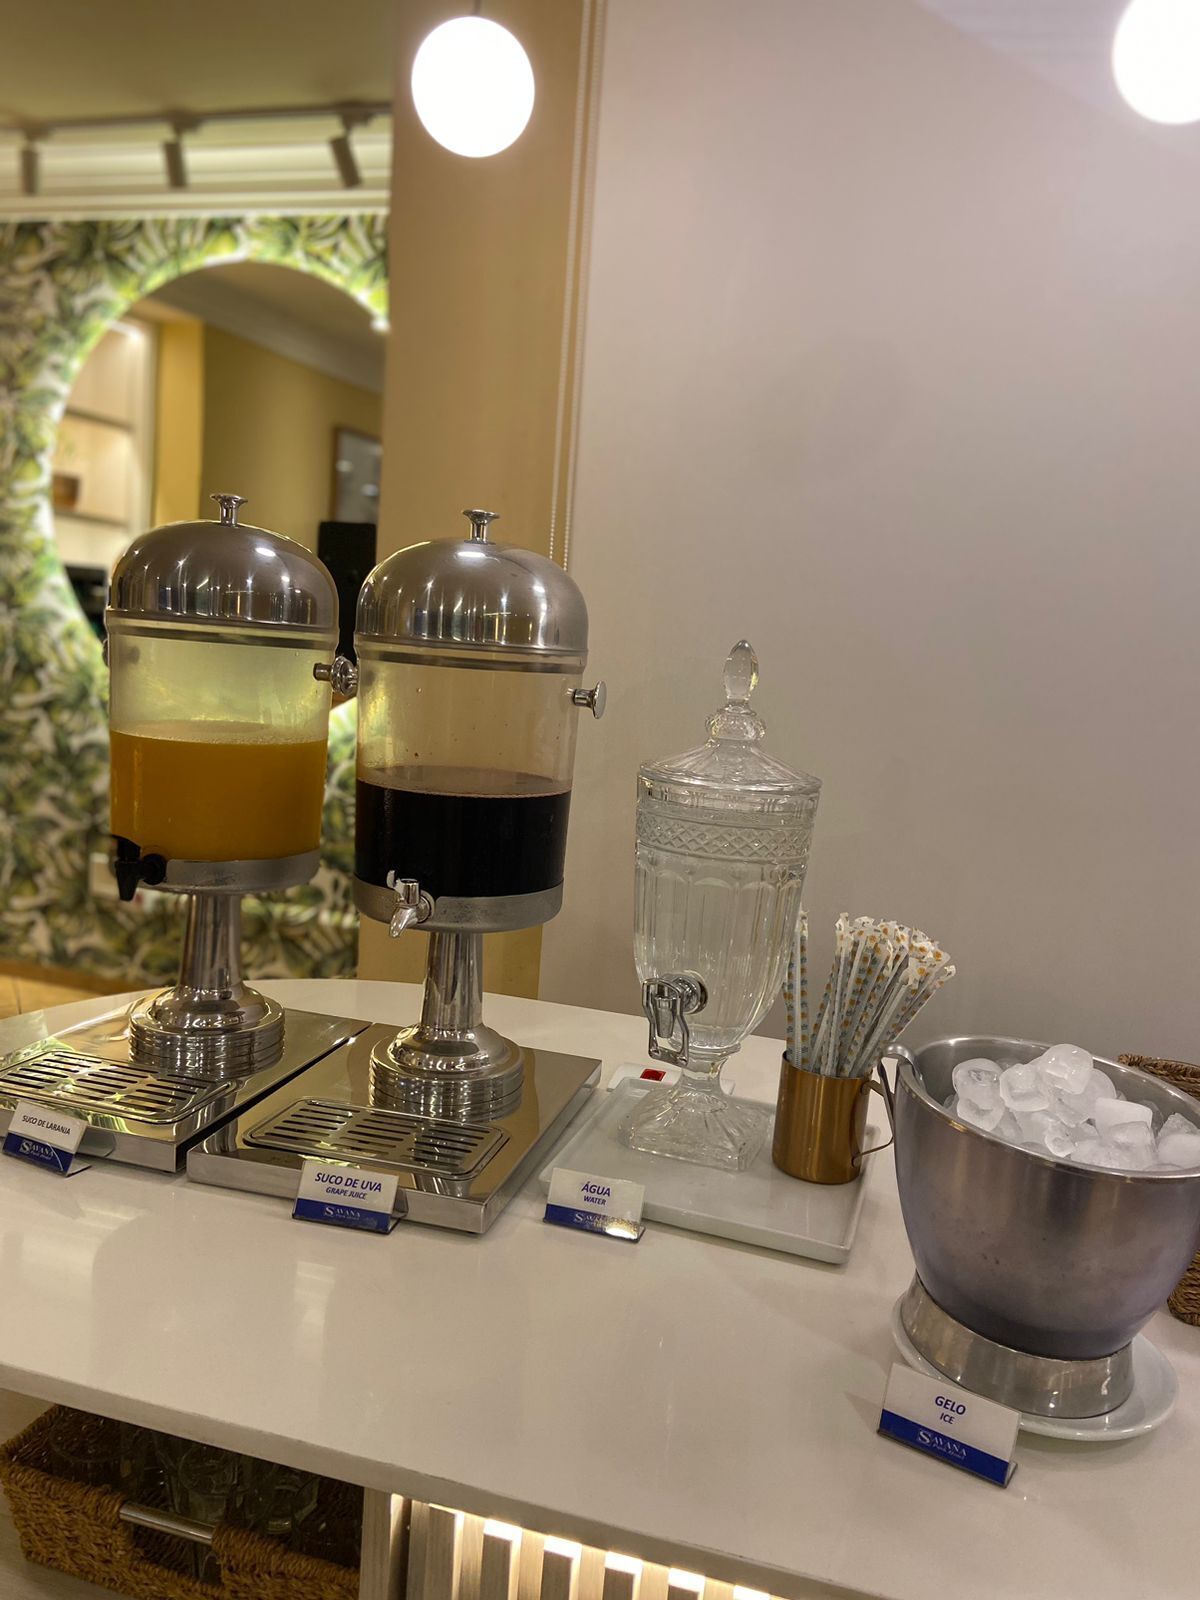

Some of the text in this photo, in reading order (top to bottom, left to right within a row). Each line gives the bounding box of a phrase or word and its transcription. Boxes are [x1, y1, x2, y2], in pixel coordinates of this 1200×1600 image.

[22, 1115, 71, 1135] SUCO DE LARANJA
[315, 1172, 382, 1193] SUCO DE UVA
[581, 1181, 611, 1197] ÁGUA
[326, 1186, 367, 1200] GRAPE JUICE
[583, 1195, 607, 1206] WATER
[935, 1395, 966, 1415] GELO
[940, 1412, 955, 1425] ICE
